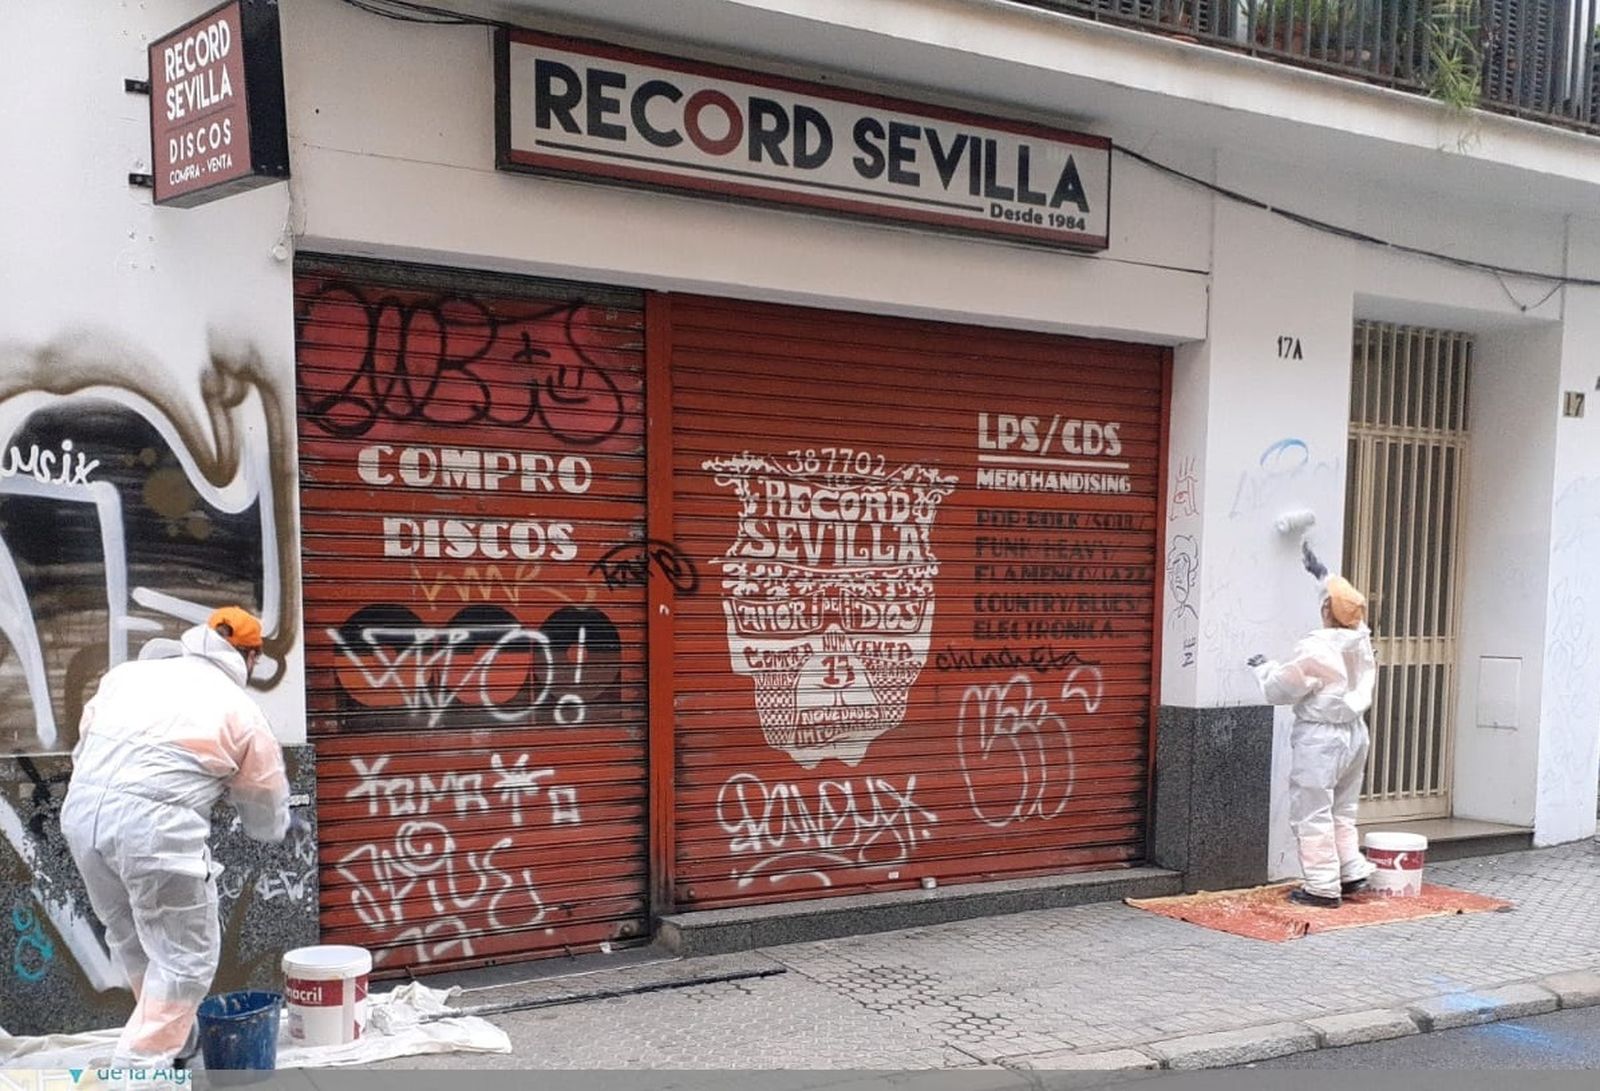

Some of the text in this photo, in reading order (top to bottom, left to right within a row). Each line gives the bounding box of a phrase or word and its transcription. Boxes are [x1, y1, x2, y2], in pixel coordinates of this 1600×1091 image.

[164, 19, 232, 83] RECORD
[165, 63, 233, 121] SEVILLA
[169, 118, 232, 165] DISCOS
[534, 57, 1090, 214] RECORD SEVILLA
[169, 166, 200, 186] COMPRA
[207, 153, 233, 173] VENTA
[990, 202, 1086, 231] Desde 1984
[1277, 335, 1303, 360] 17A
[1565, 391, 1585, 417] 17
[977, 412, 1123, 456] LPS/CDS
[357, 445, 593, 494] COMPRO
[786, 448, 886, 476] 387702
[976, 467, 1132, 493] MERCHANDISING
[758, 479, 911, 523] RECORD
[382, 517, 579, 561] DISCOS
[741, 519, 924, 567] SEVILLA
[737, 598, 921, 631] AMOR DE DIOS
